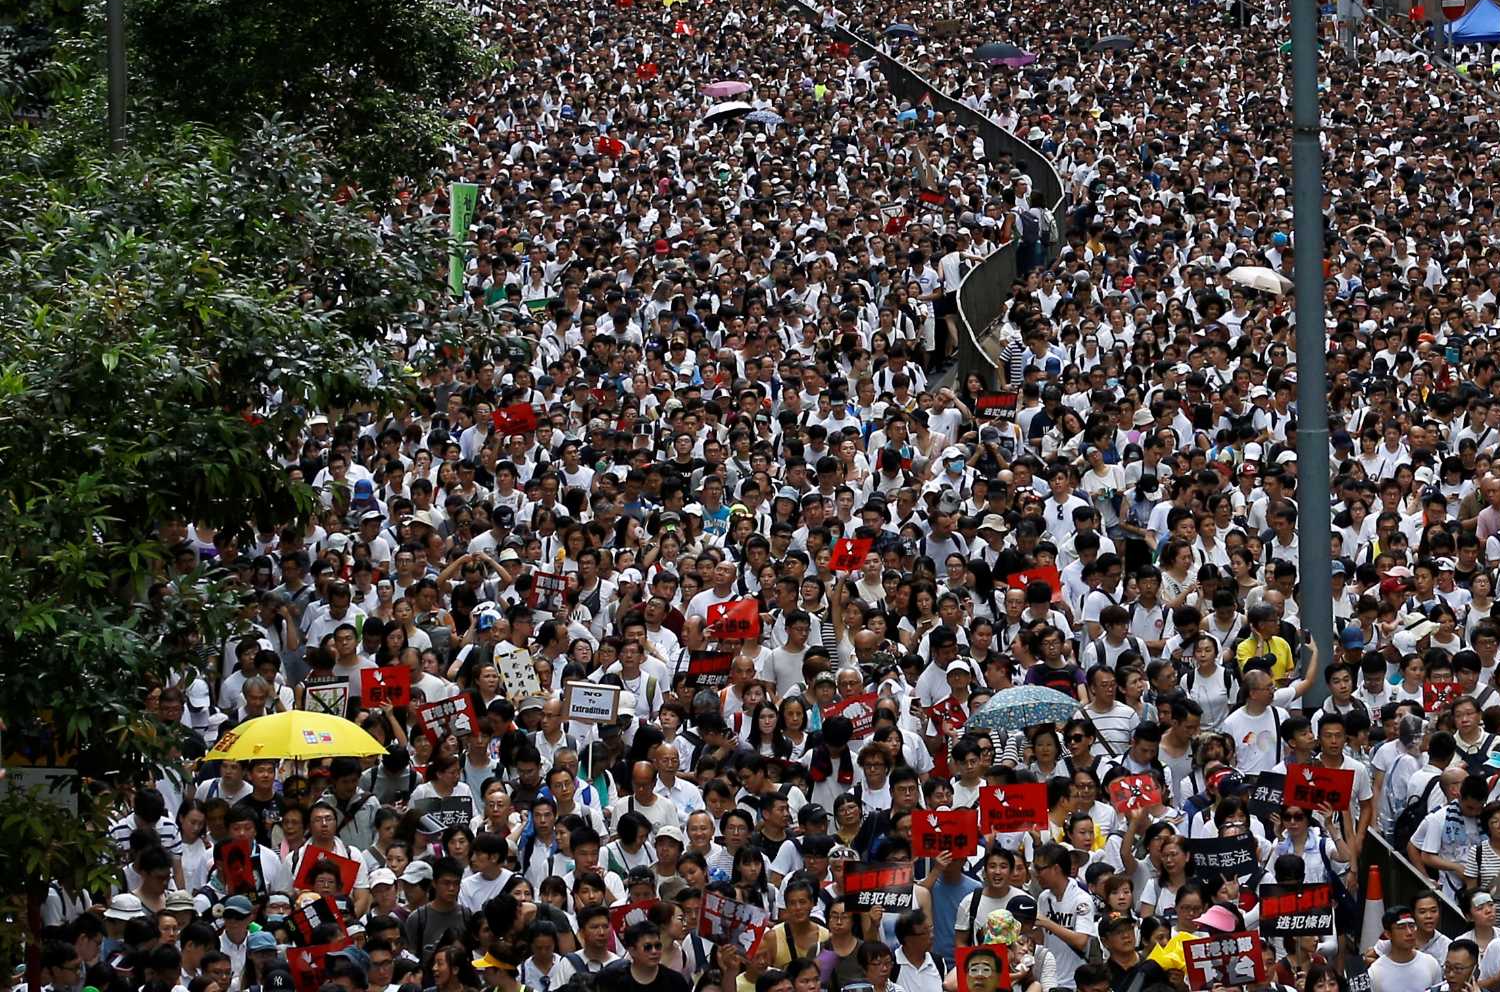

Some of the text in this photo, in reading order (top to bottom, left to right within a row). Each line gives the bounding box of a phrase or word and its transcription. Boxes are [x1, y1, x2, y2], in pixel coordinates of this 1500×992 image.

[857, 891, 912, 907] 逃犯條例
[1275, 914, 1331, 929] 逃犯條例
